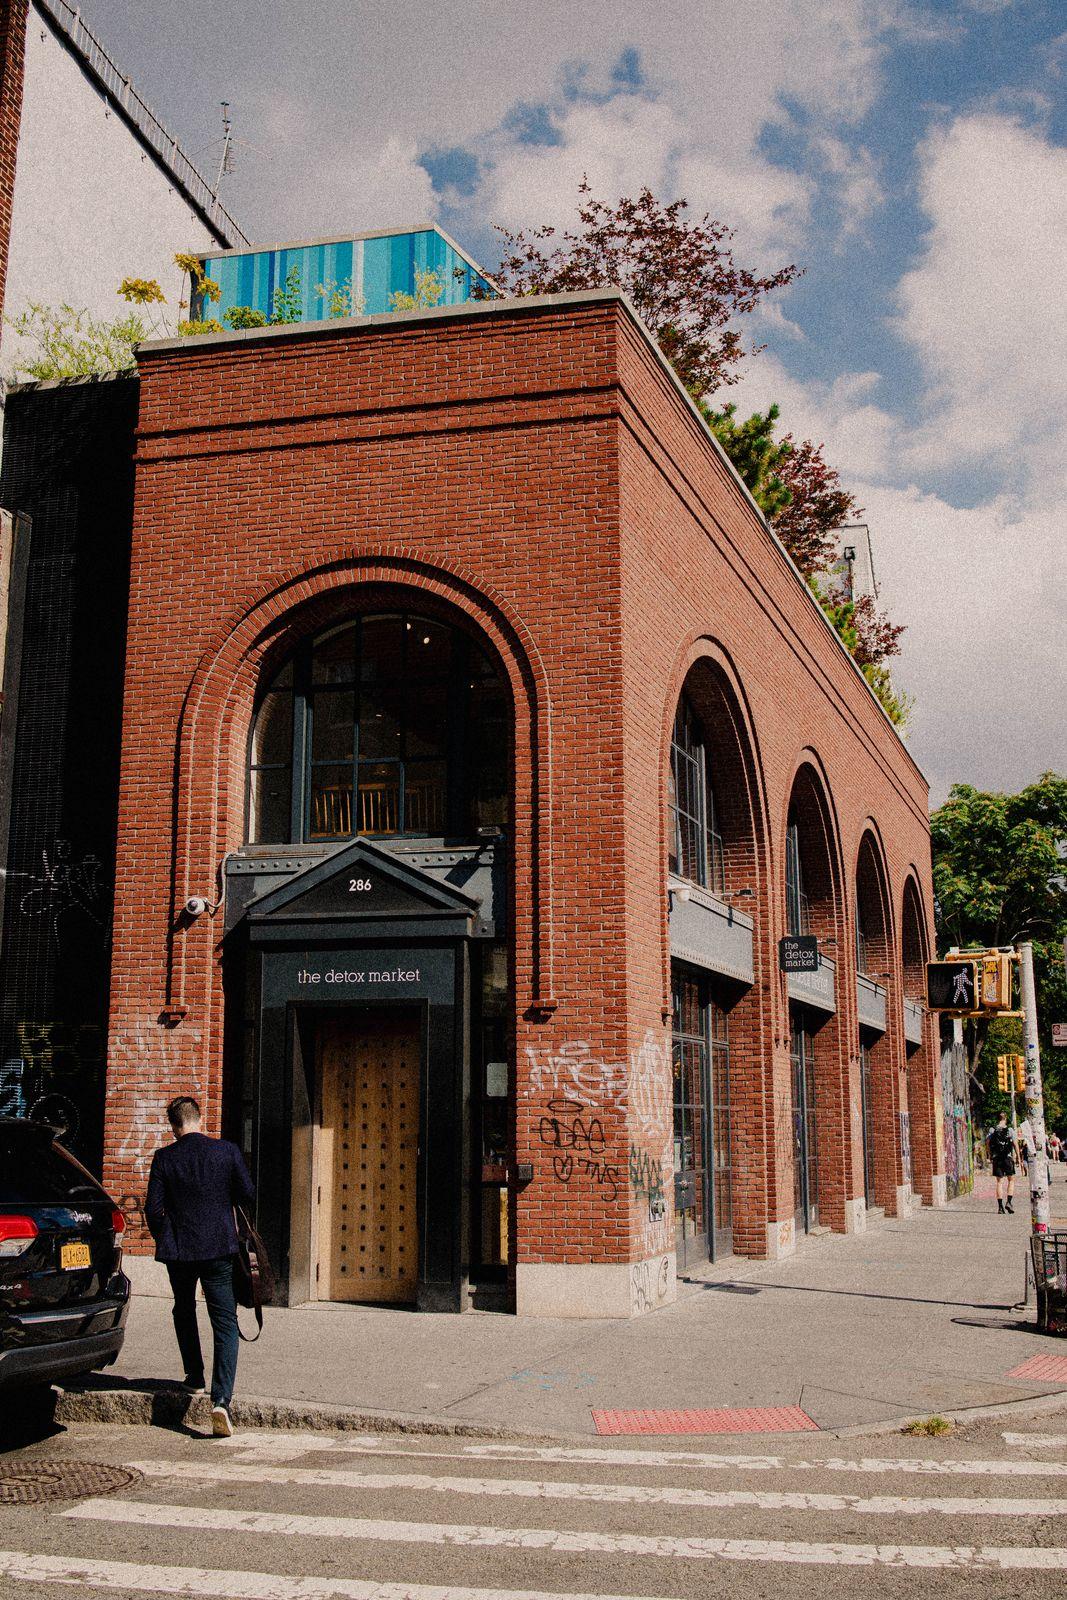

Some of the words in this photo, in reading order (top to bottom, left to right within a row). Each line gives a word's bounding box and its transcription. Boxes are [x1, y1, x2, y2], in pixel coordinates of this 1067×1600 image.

[349, 879, 372, 892] 286
[784, 941, 799, 950] the
[785, 949, 815, 960] detox
[785, 959, 815, 967] market
[297, 970, 321, 984] the
[324, 969, 366, 983] detox
[368, 968, 420, 982] market
[72, 1210, 92, 1224] Jeep
